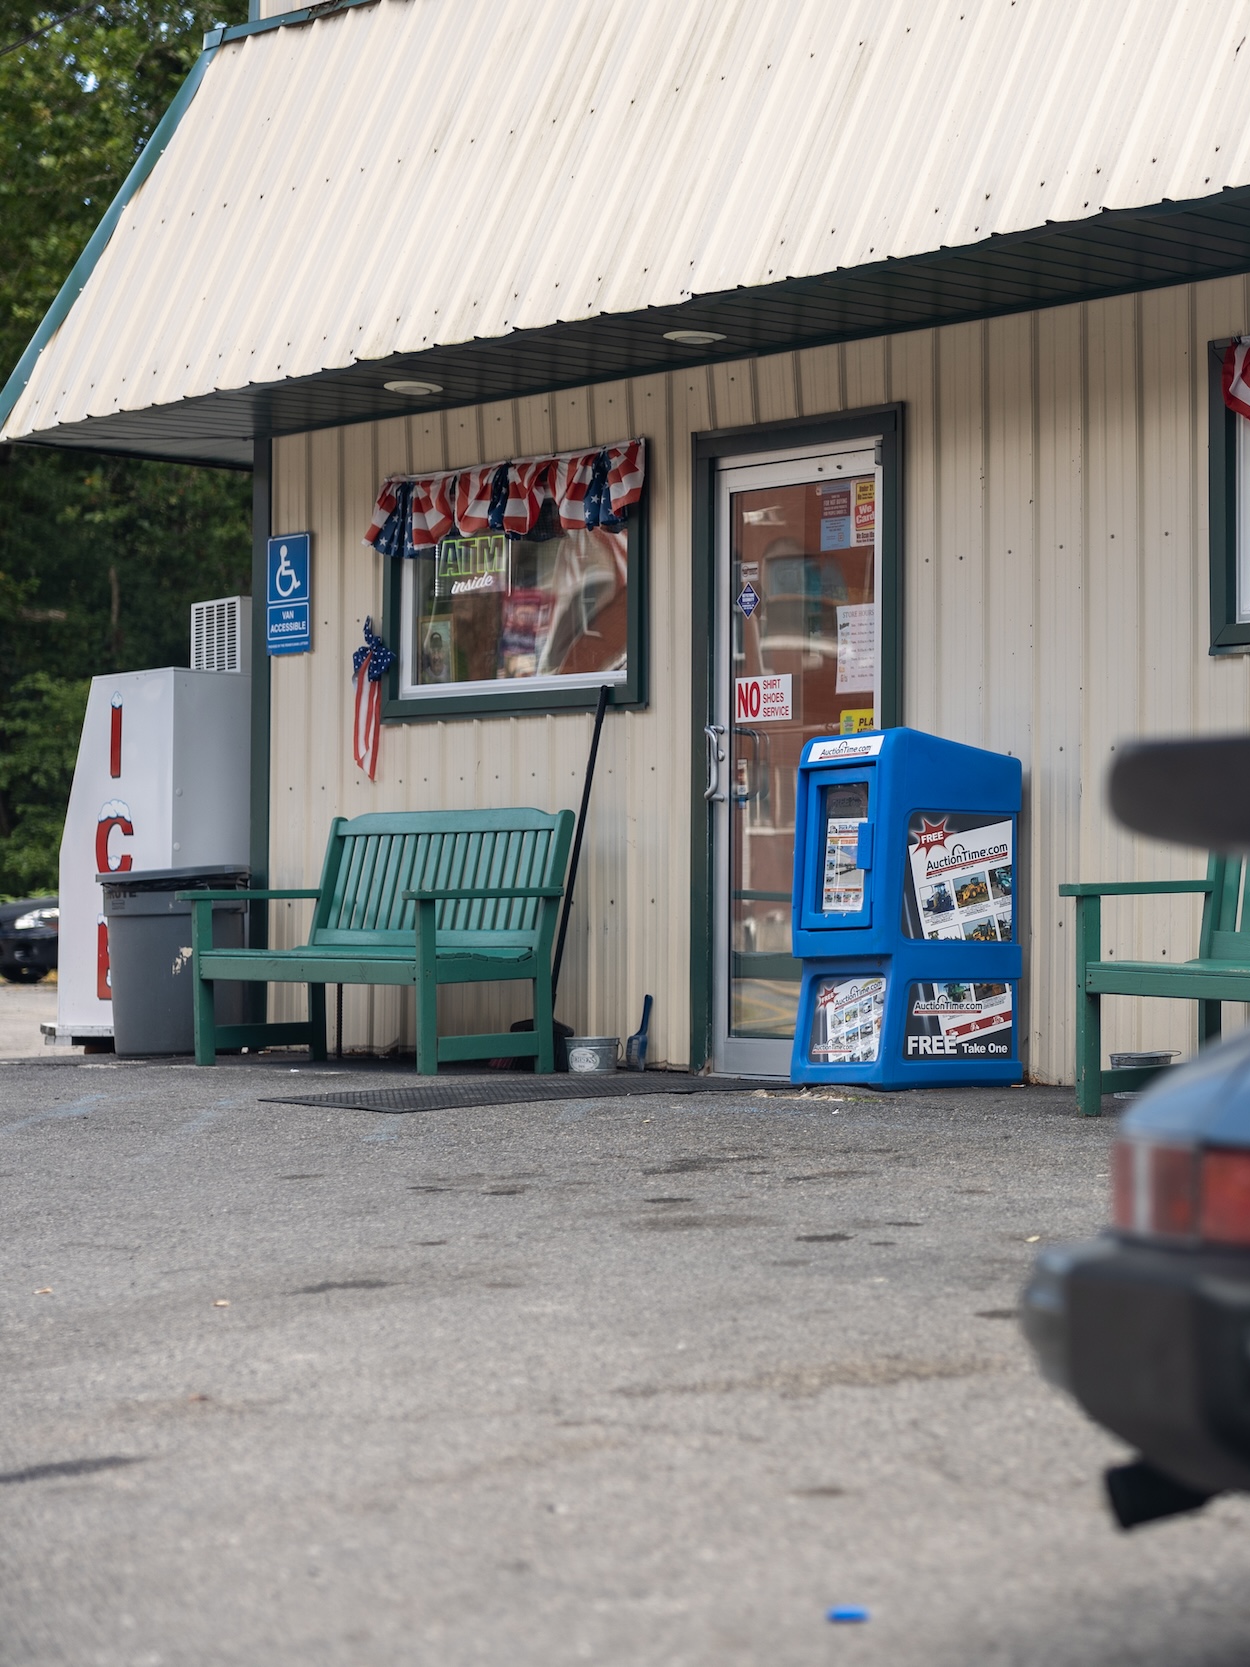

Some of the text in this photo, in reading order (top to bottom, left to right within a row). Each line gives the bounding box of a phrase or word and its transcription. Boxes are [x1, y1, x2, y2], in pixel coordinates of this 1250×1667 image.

[859, 504, 872, 514] We
[856, 511, 875, 524] Card
[439, 534, 506, 577] ATM
[451, 572, 494, 594] inside
[282, 610, 295, 620] VAN
[842, 609, 875, 618] STORE HOURS
[270, 621, 307, 633] ACCESSIBLE
[762, 679, 781, 690] SHIRT
[737, 681, 761, 718] NO
[762, 692, 785, 704] SHOES
[762, 706, 790, 717] SERVICE
[820, 743, 872, 756] AuctionTime.com
[921, 831, 945, 844] FREE
[926, 843, 1008, 872] AuctionTime.com
[835, 981, 883, 1006] AuctionTime.com
[915, 999, 983, 1010] AuctionTime.com
[907, 1035, 1008, 1055] FREE Take One
